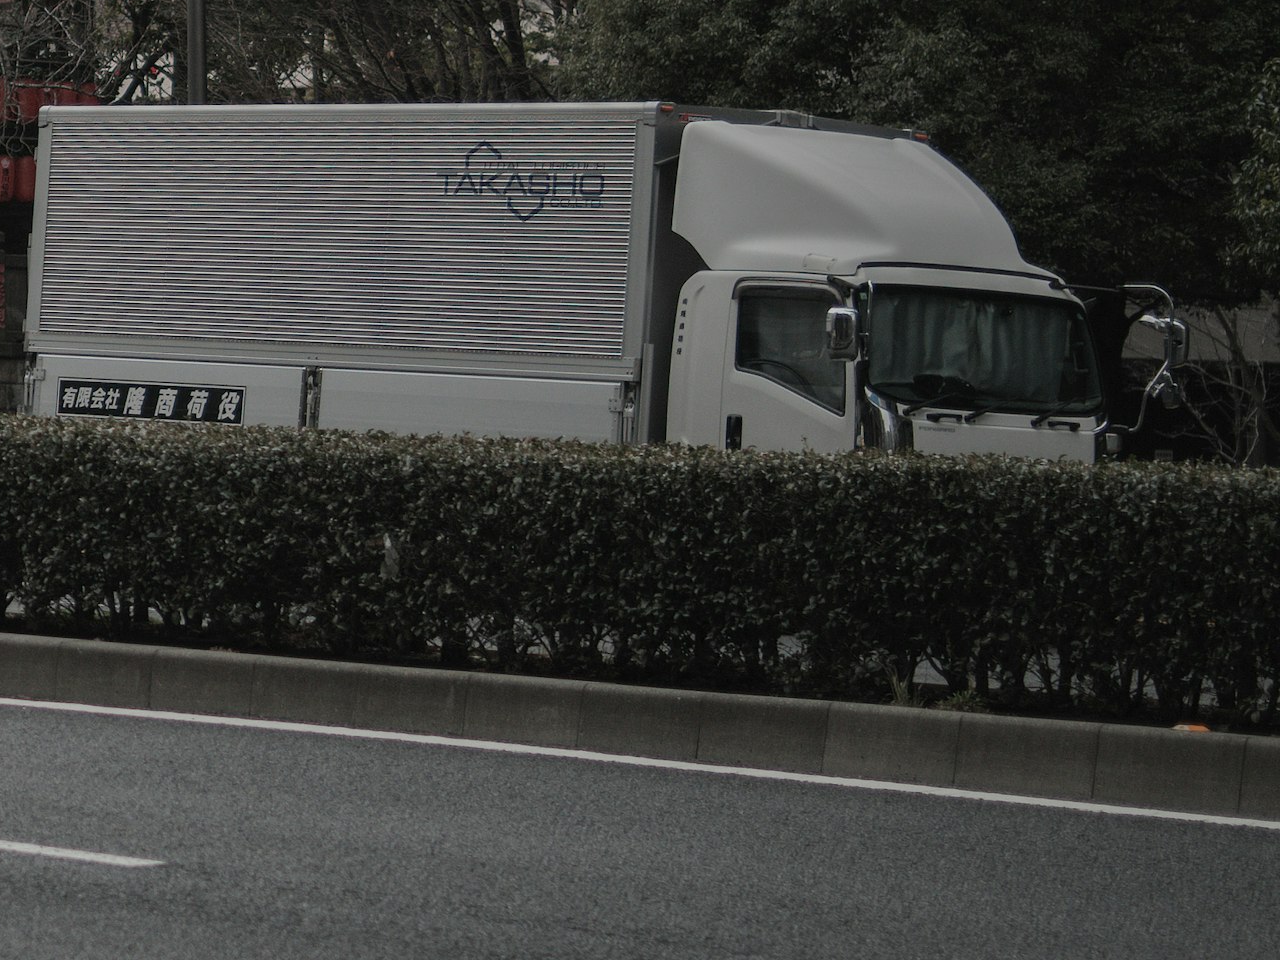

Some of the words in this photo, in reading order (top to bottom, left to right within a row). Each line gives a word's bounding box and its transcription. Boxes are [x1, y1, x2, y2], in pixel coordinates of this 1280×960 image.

[437, 172, 605, 196] TAKASHO
[62, 387, 121, 410] 有限会社
[123, 386, 240, 421] 隆商荷役
